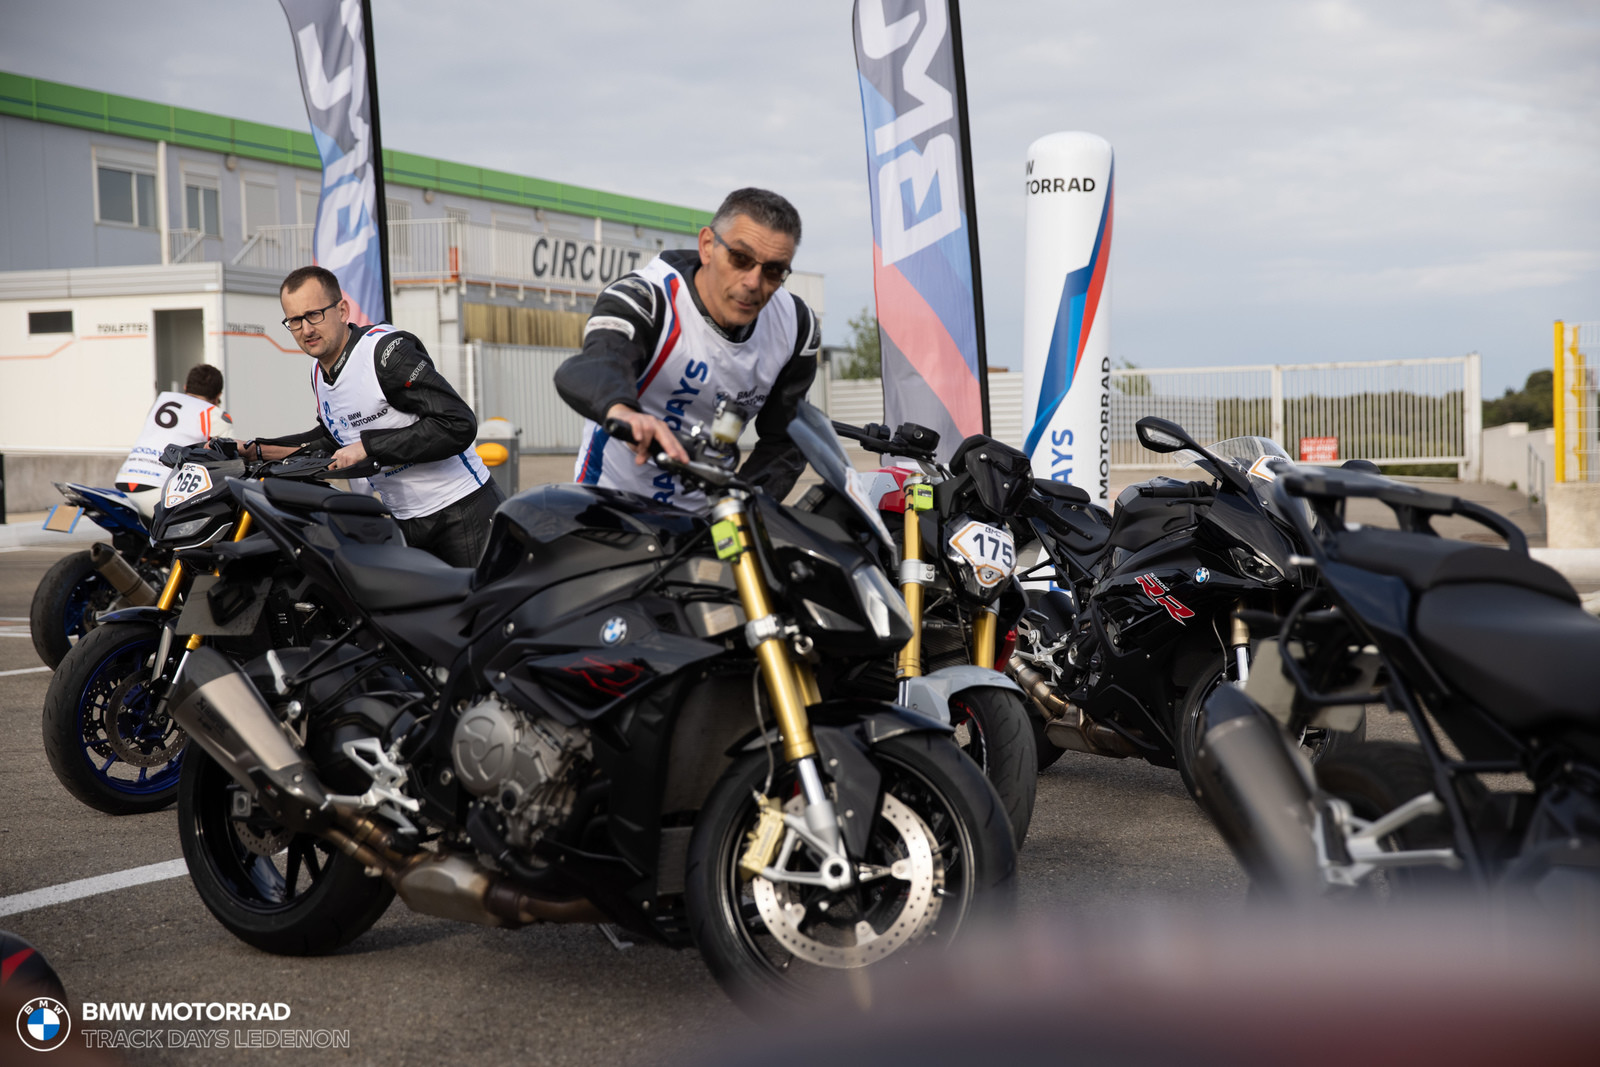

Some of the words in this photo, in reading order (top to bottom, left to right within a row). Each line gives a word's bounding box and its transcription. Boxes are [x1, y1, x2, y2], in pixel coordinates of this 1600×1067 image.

[1026, 177, 1096, 195] TORRAD
[532, 238, 640, 283] CIRCUIT
[155, 401, 182, 429] 6
[347, 411, 362, 421] BMW
[350, 408, 388, 428] MOTORRAD
[1099, 357, 1111, 500] MOTORRAD
[1051, 428, 1074, 486] AYS
[174, 472, 202, 493] 166
[972, 533, 1013, 568] 175
[985, 570, 994, 579] 3
